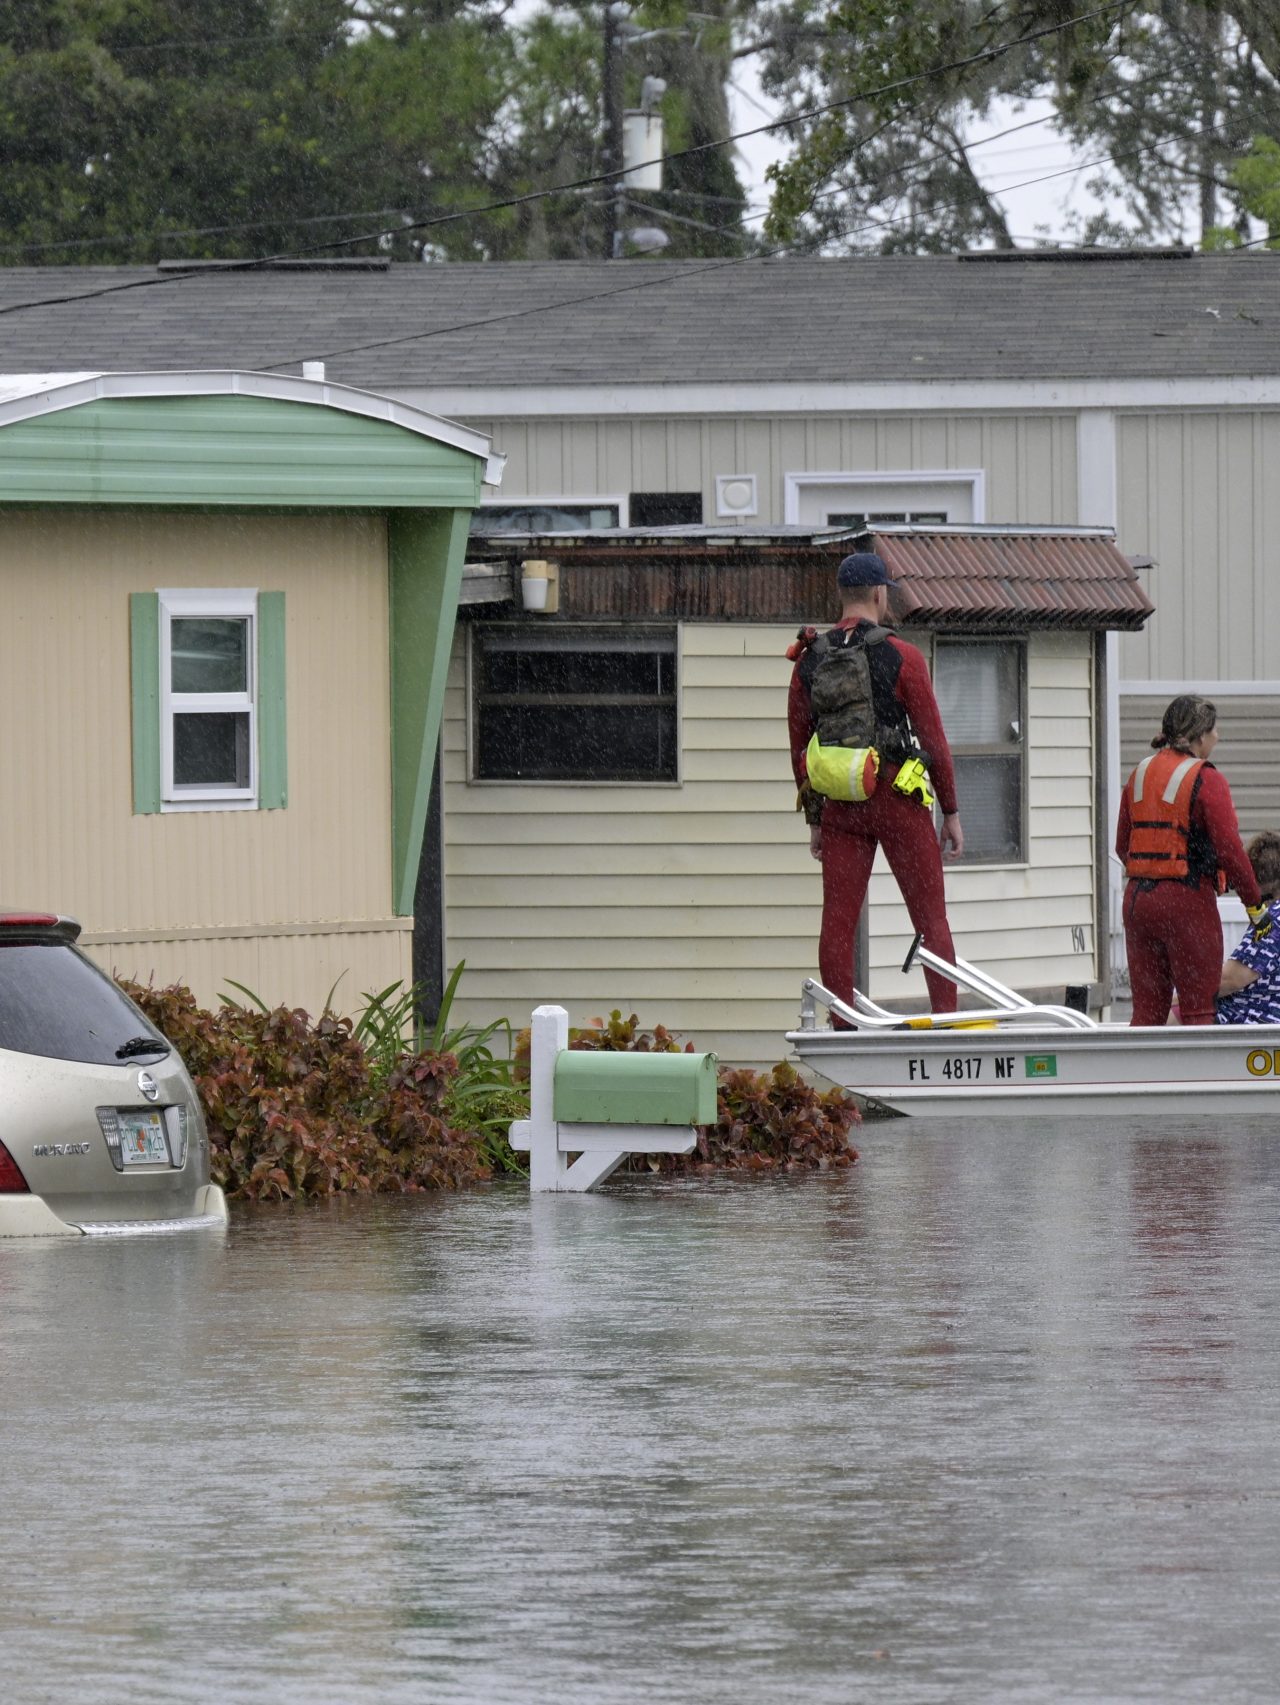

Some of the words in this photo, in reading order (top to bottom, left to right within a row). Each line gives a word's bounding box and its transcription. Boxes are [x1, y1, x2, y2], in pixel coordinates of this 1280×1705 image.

[909, 1059, 930, 1080] FL
[942, 1058, 982, 1079] 4817
[995, 1057, 1015, 1078] NF
